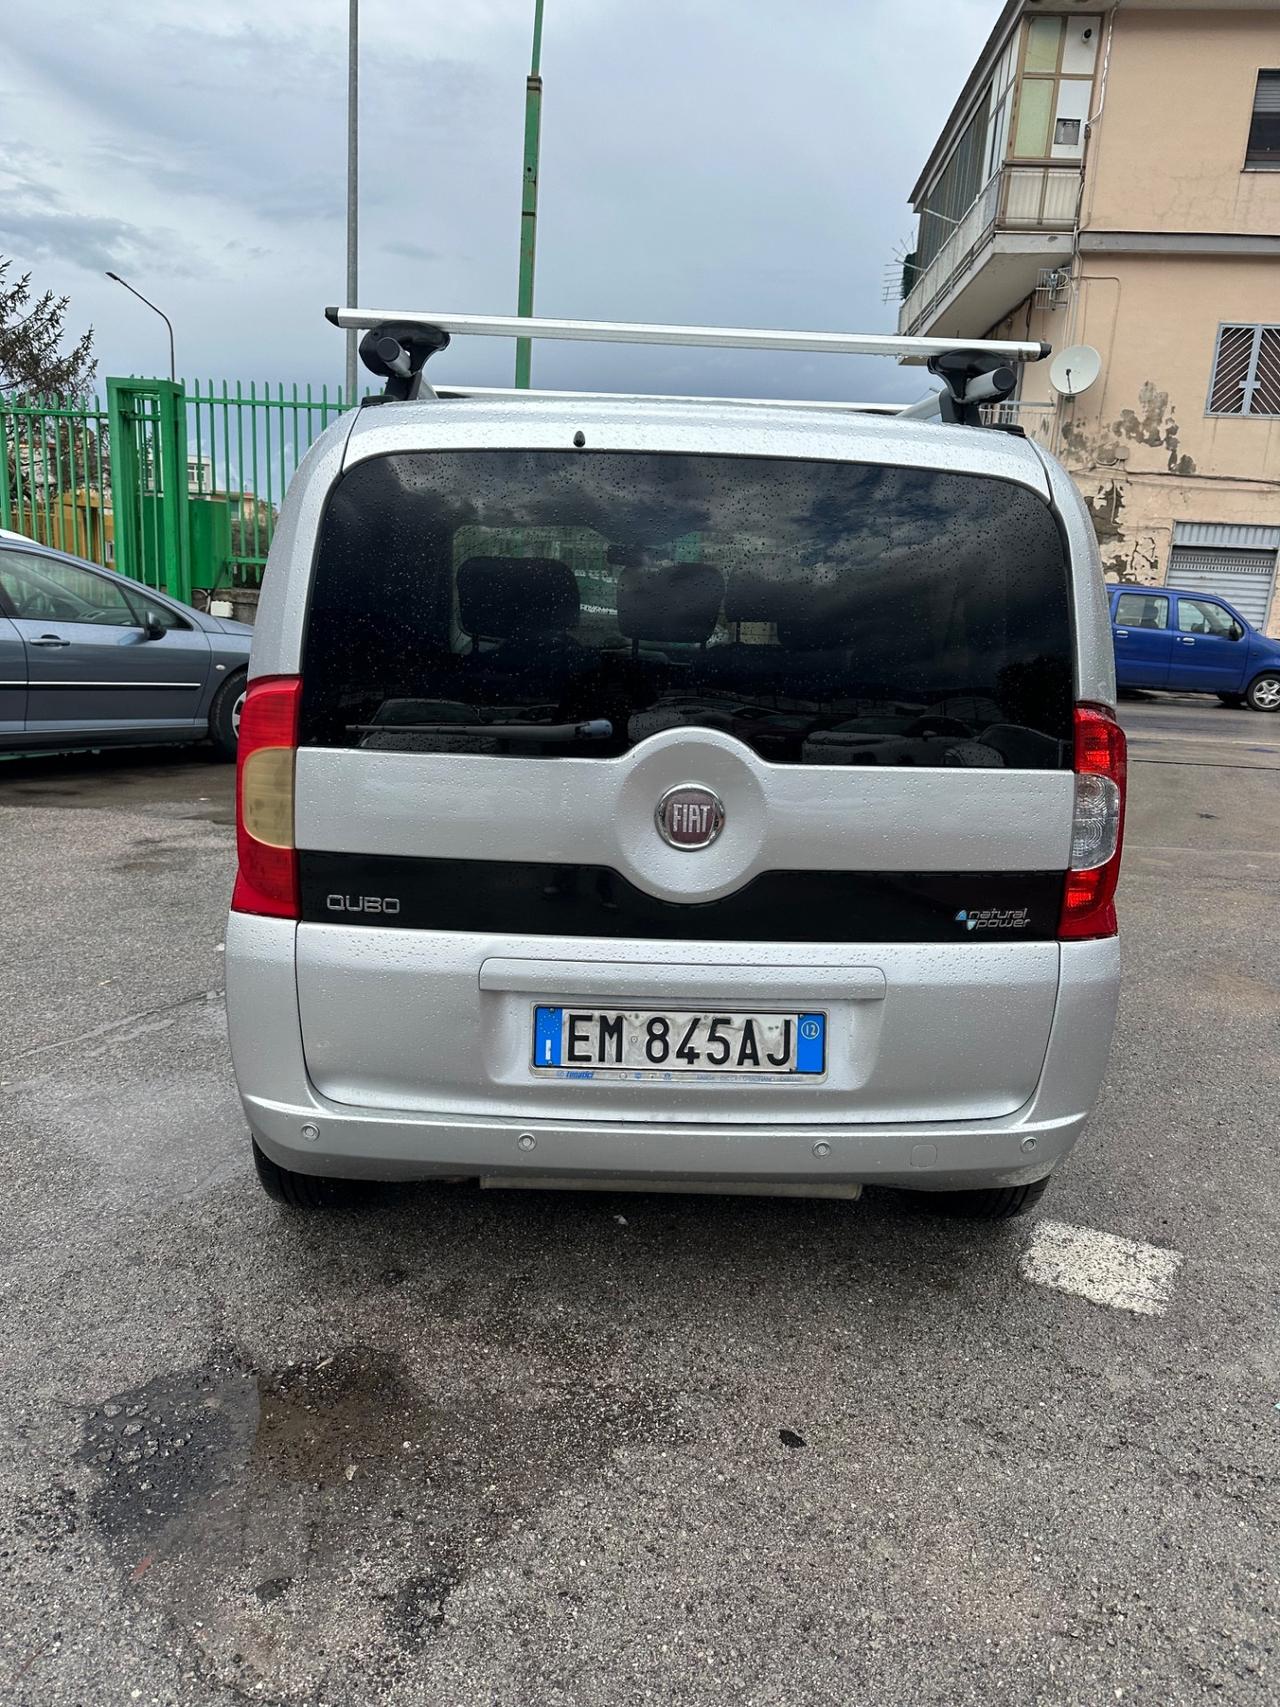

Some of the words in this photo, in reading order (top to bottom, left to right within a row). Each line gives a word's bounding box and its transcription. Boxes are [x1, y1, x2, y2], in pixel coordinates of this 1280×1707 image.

[672, 803, 711, 833] FIAT
[326, 894, 400, 914] QUBO
[968, 907, 1028, 920] natural
[975, 919, 1031, 930] power
[567, 1013, 625, 1064] EM
[645, 1016, 792, 1067] 845AJ
